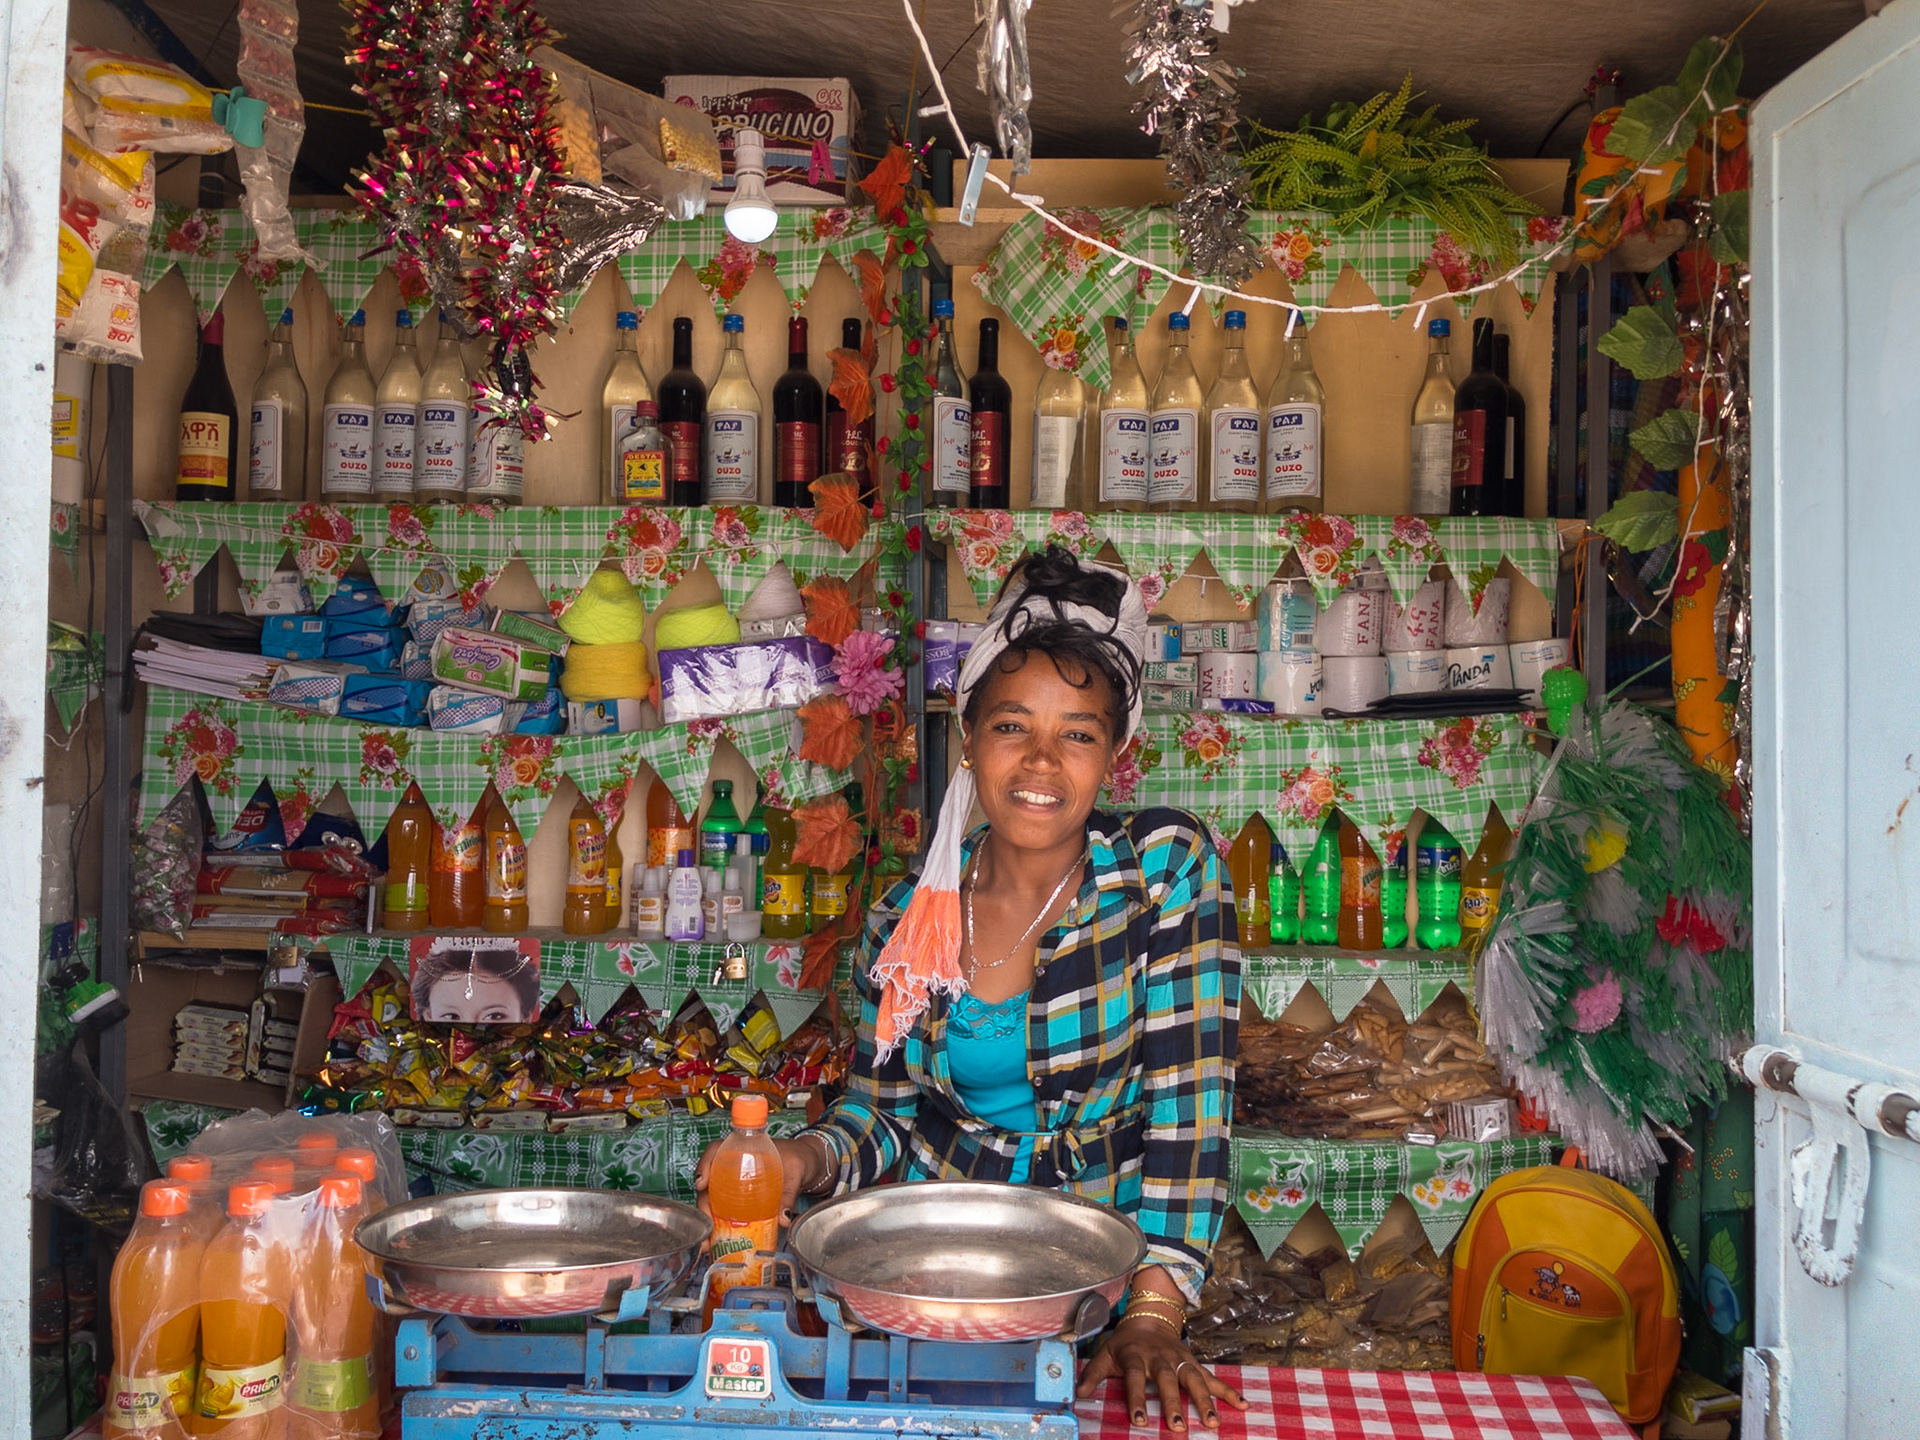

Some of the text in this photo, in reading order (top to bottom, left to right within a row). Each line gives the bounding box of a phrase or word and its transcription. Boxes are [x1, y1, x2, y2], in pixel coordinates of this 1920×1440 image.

[816, 88, 842, 106] OK
[340, 461, 368, 470] OUZO
[385, 461, 412, 470] OUZO
[426, 458, 453, 467] OUZO
[1275, 463, 1303, 473] OUZO
[716, 467, 742, 475] OUZO
[1121, 468, 1145, 478] OUZO
[1154, 469, 1179, 478] OUZO
[1233, 468, 1258, 477] OUZO
[1425, 599, 1441, 649] FANA
[452, 645, 502, 672] Comfort
[1449, 662, 1491, 687] PANDA
[711, 1236, 754, 1264] Mirinda
[729, 1346, 751, 1364] 10
[730, 1363, 743, 1373] Kg
[241, 1375, 280, 1396] PRIGAT
[712, 1377, 764, 1392] Master
[116, 1393, 158, 1408] PRIGAT
